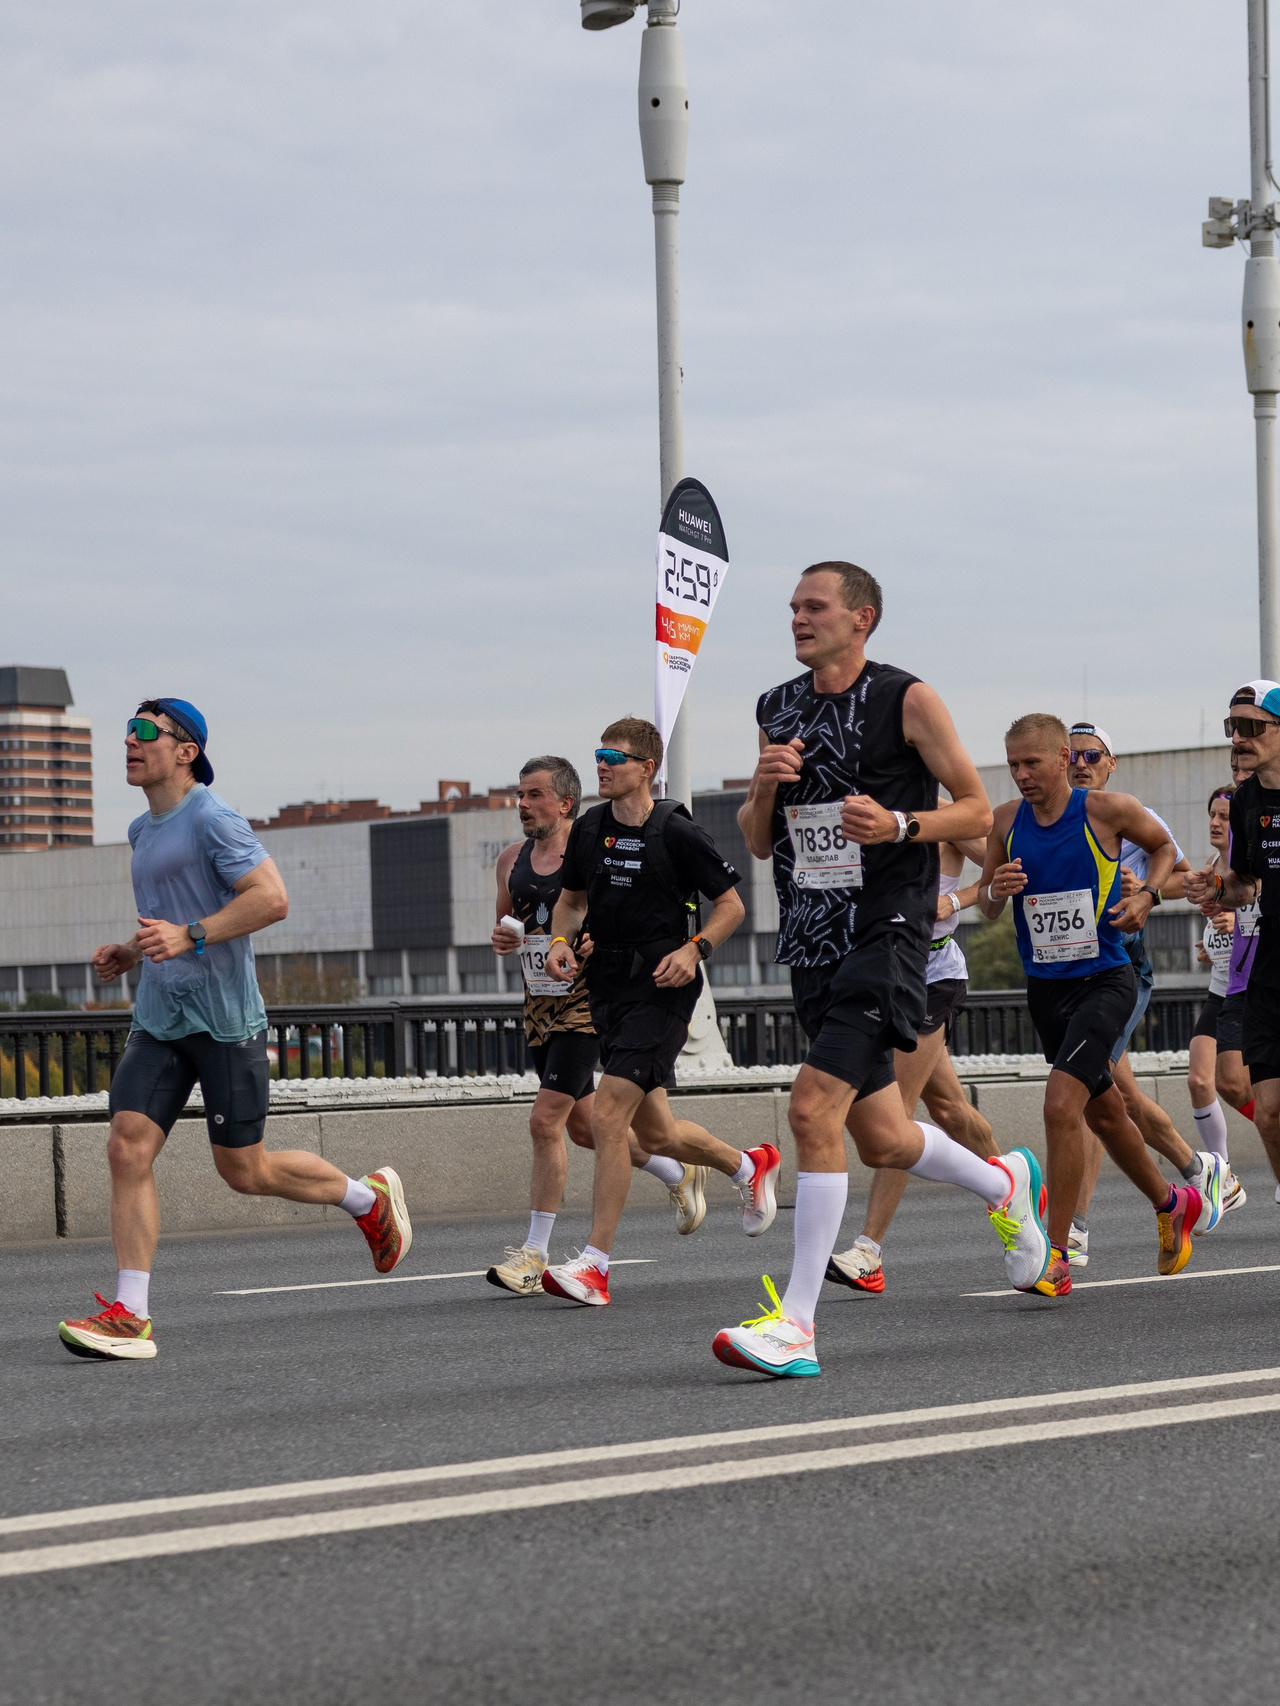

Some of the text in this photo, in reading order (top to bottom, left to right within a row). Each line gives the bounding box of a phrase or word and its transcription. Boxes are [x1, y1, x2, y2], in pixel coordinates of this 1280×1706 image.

[679, 508, 712, 535] HUAWEI
[795, 825, 848, 853] 7838
[1032, 909, 1085, 934] 3756
[1050, 934, 1070, 942] ДЕНИС
[1036, 949, 1044, 960] B
